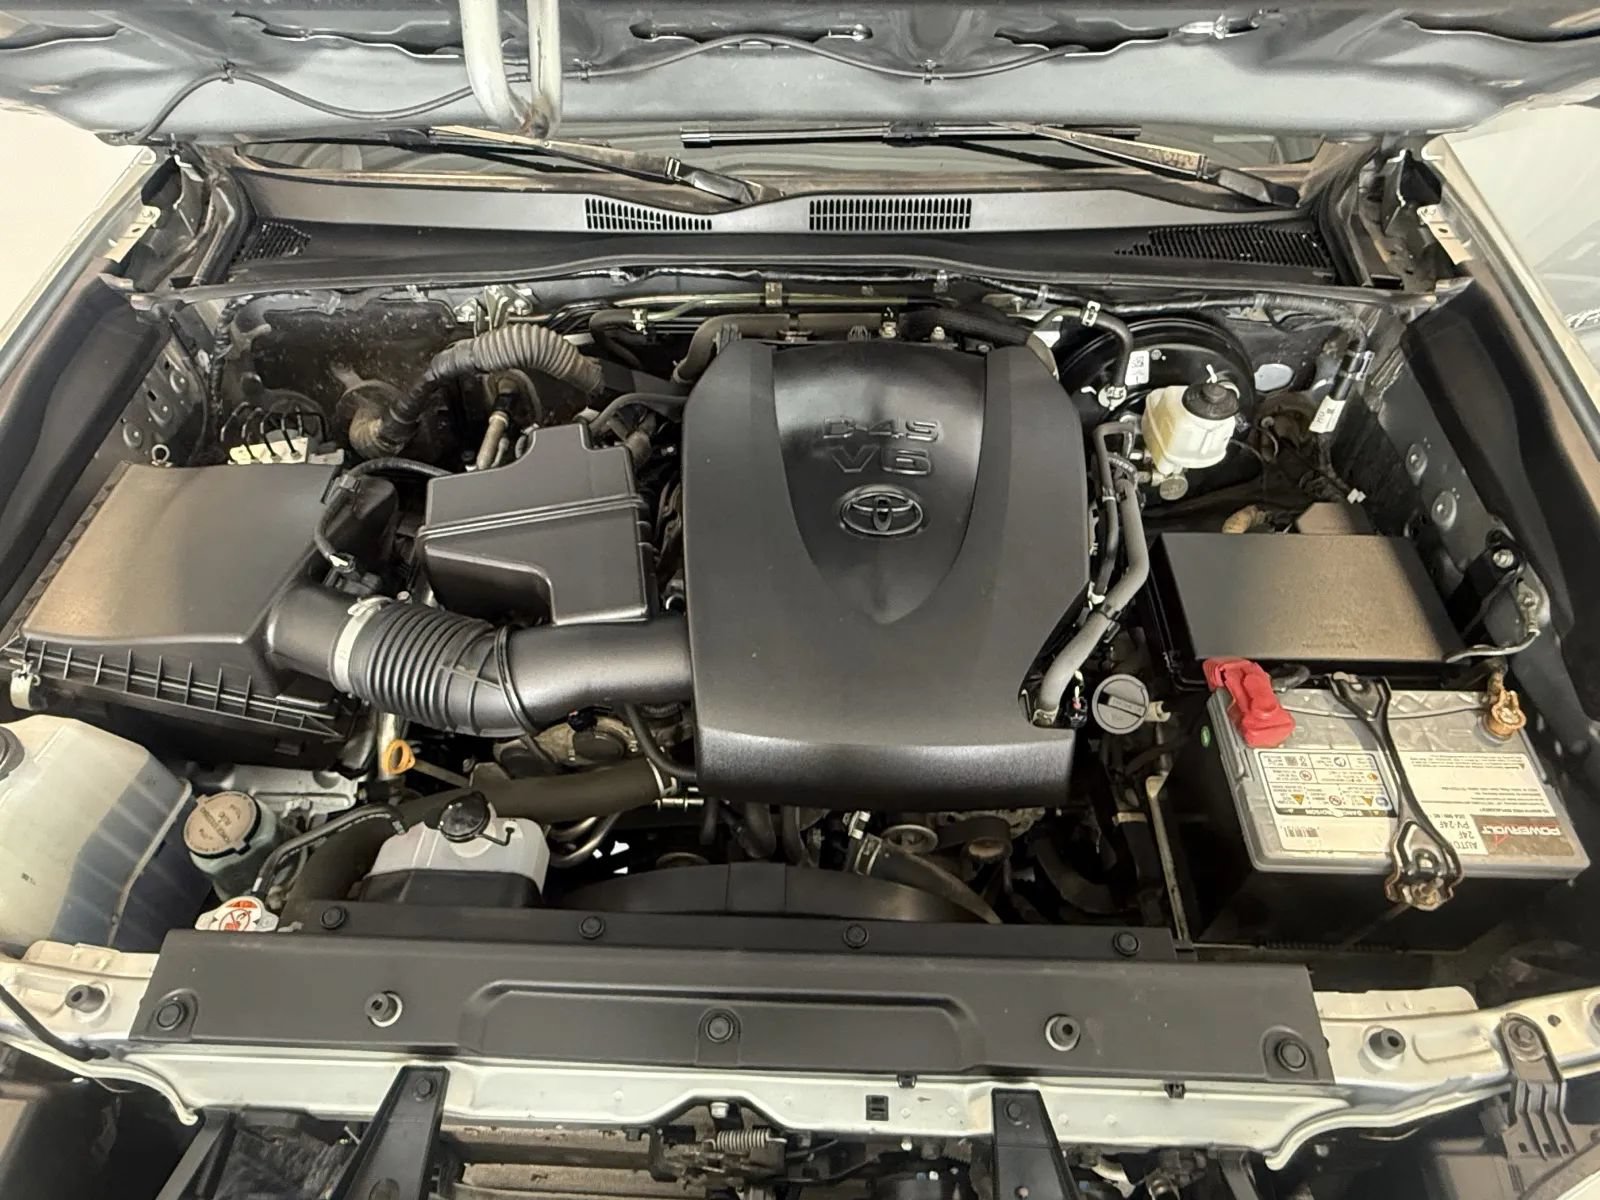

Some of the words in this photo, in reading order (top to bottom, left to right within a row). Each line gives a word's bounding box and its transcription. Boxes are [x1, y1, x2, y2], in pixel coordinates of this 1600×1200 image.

[823, 417, 940, 442] D-4S
[828, 445, 931, 474] V6
[1439, 820, 1470, 829] PV-24F
[1459, 831, 1475, 839] 24F
[1481, 824, 1561, 836] POWERVOLT
[1455, 841, 1478, 850] AUTO
